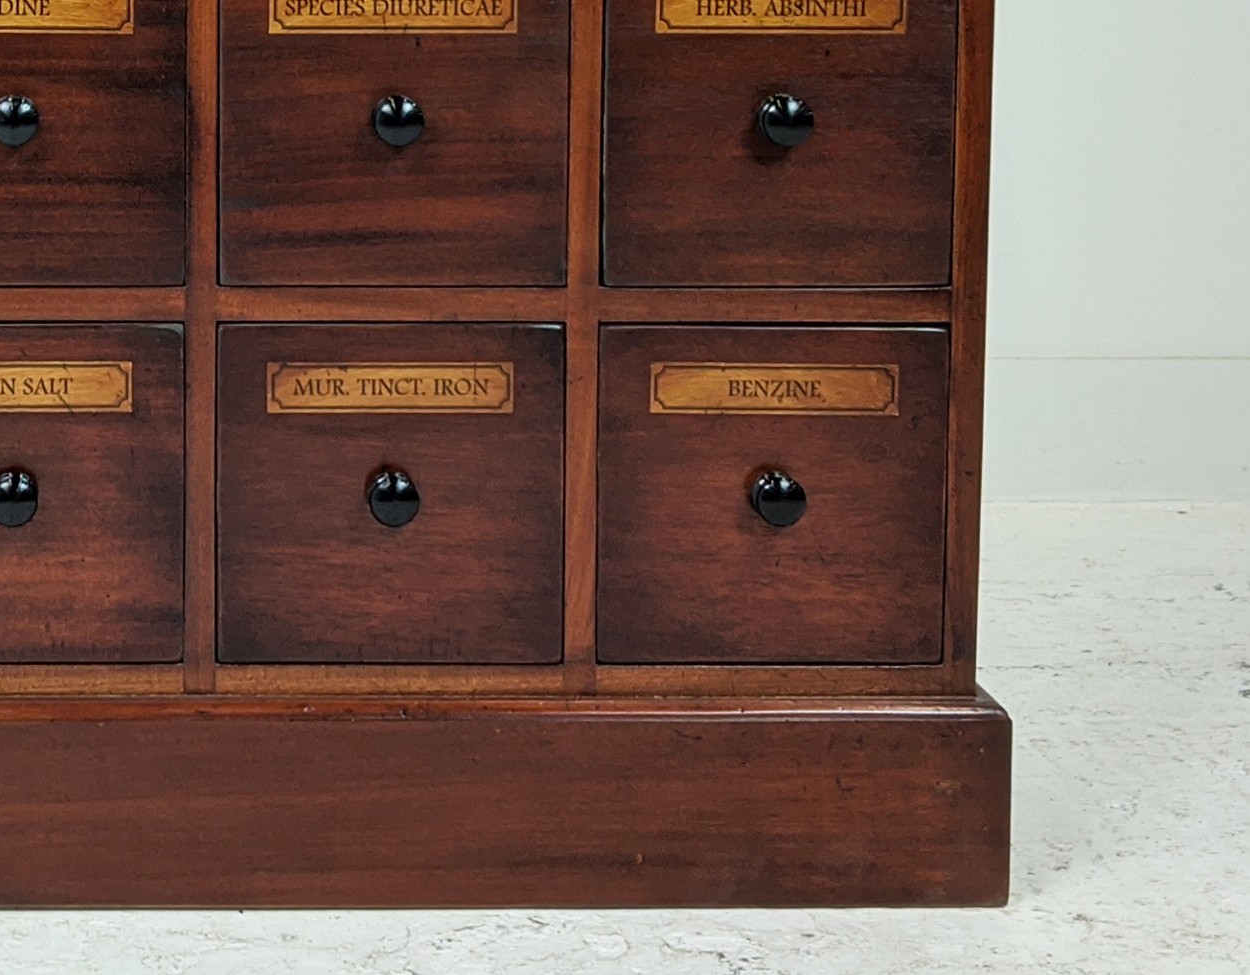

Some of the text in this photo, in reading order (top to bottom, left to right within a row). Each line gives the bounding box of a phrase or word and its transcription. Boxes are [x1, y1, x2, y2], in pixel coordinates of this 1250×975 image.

[696, 0, 867, 17] HERB. ABSINTHI
[23, 378, 73, 396] SALT
[293, 378, 489, 396] MUR. TINCT. IRON
[729, 379, 821, 398] BENZINE
